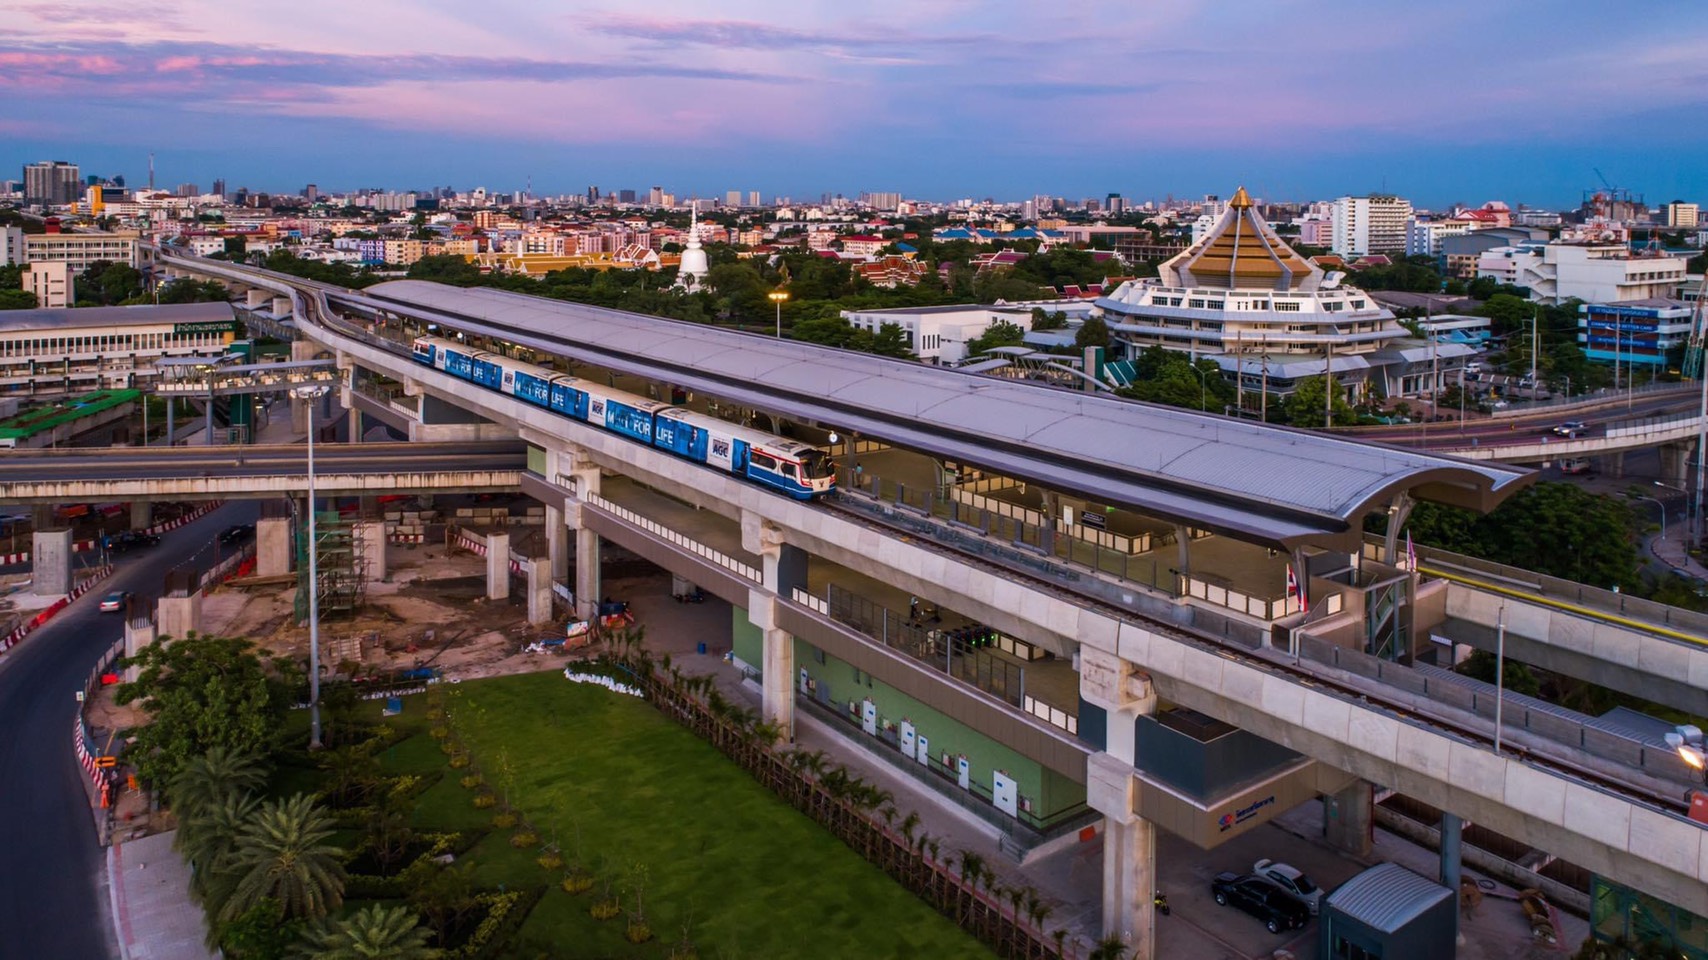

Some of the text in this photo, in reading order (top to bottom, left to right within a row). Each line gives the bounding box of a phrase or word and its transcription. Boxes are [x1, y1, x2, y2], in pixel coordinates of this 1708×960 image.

[534, 387, 548, 401] FOR
[551, 391, 564, 407] LIFE
[633, 419, 651, 437] FOR
[656, 426, 674, 445] LIFE
[712, 443, 729, 458] AGC
